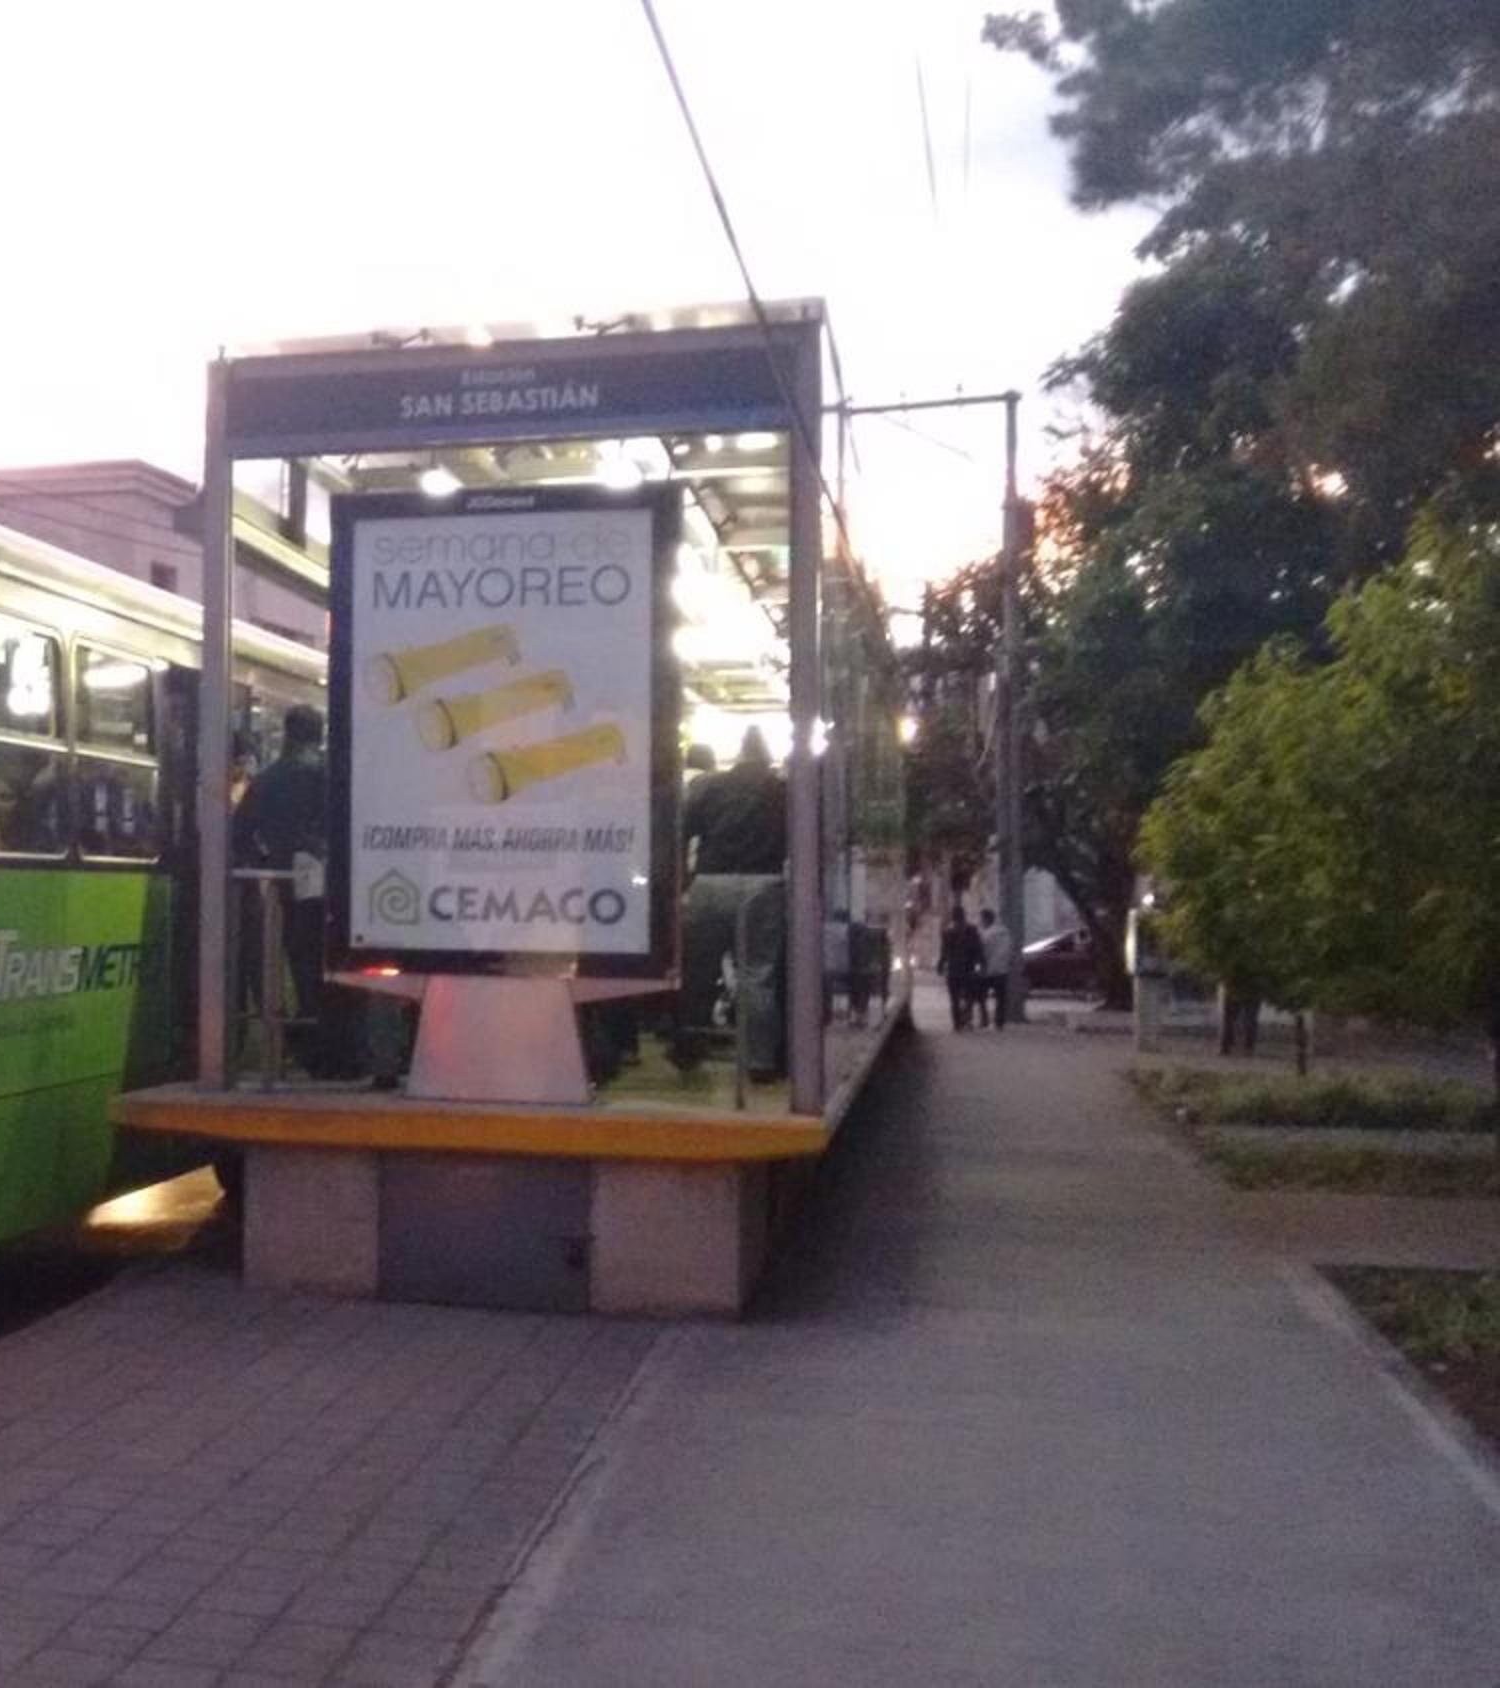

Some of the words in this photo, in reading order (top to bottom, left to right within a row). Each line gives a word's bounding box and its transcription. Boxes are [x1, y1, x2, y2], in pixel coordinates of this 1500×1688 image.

[400, 395, 452, 418] SAN
[460, 379, 599, 416] SEBASTIÁN
[372, 530, 555, 566] semana
[568, 525, 632, 561] de
[371, 564, 632, 609] MAYOREO
[502, 826, 578, 851] AHORRA
[582, 820, 636, 852] MÁS!
[428, 885, 626, 925] CEMACO
